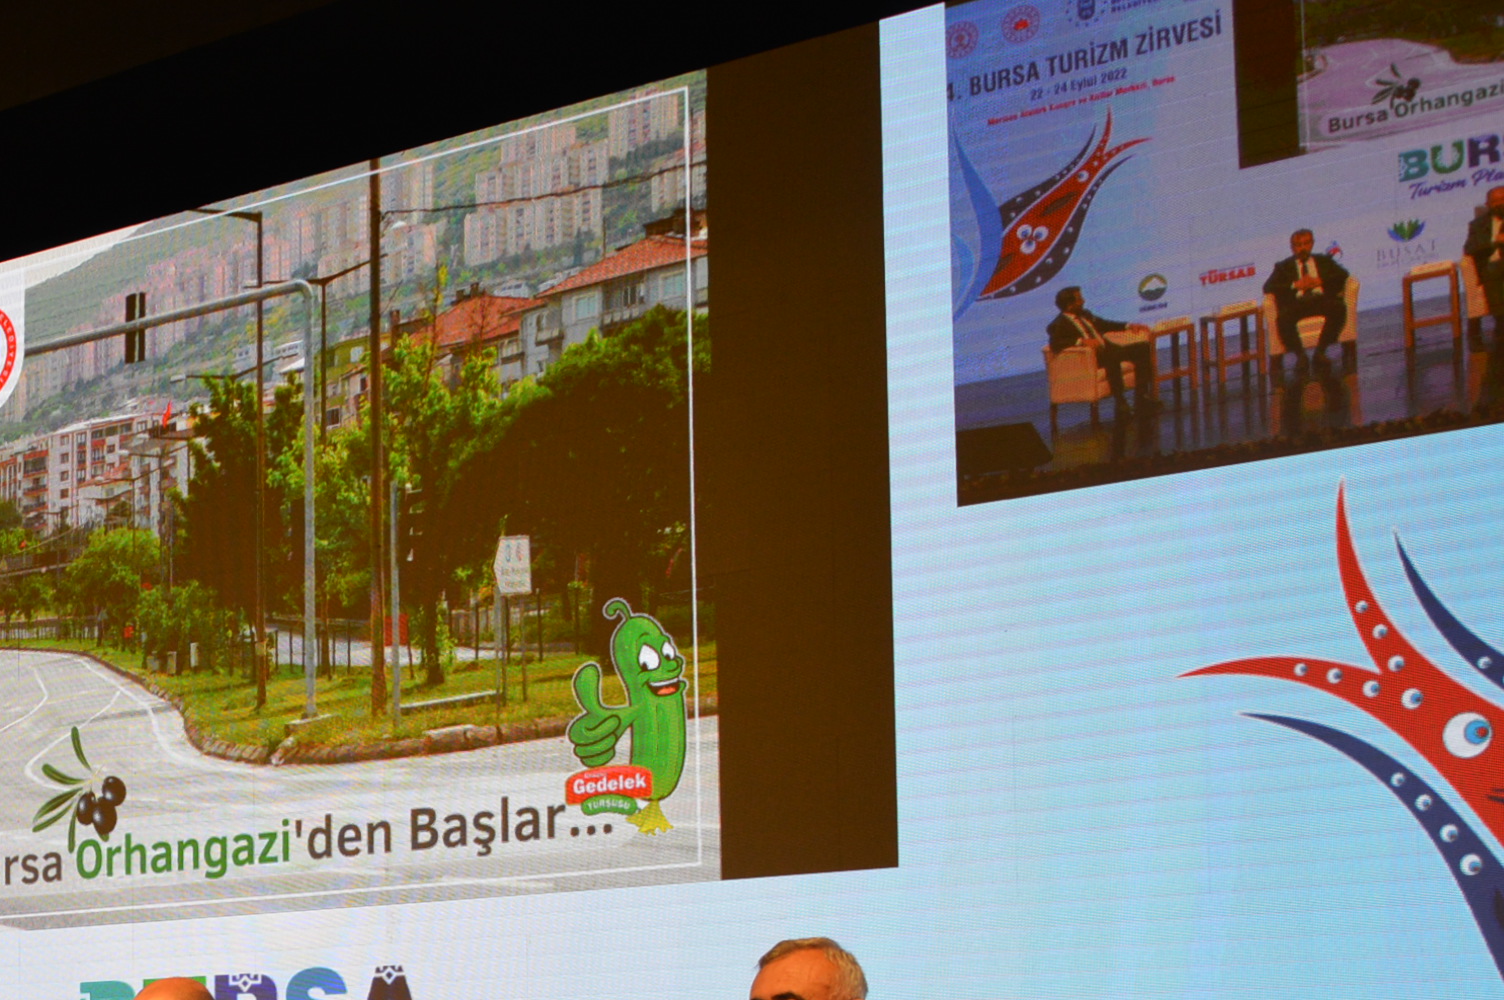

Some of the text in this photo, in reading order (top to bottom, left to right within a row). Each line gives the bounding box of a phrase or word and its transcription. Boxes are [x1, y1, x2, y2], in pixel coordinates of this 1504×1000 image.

[970, 61, 1039, 97] BURSA
[1046, 38, 1128, 78] TURİZM
[1135, 9, 1222, 57] ZİRVESİ
[1328, 108, 1389, 134] Bursa
[1199, 265, 1257, 286] TÜRSAB
[572, 772, 647, 796] Gedelek
[75, 813, 393, 881] Orhangazi'den
[410, 795, 614, 858] Başlar...
